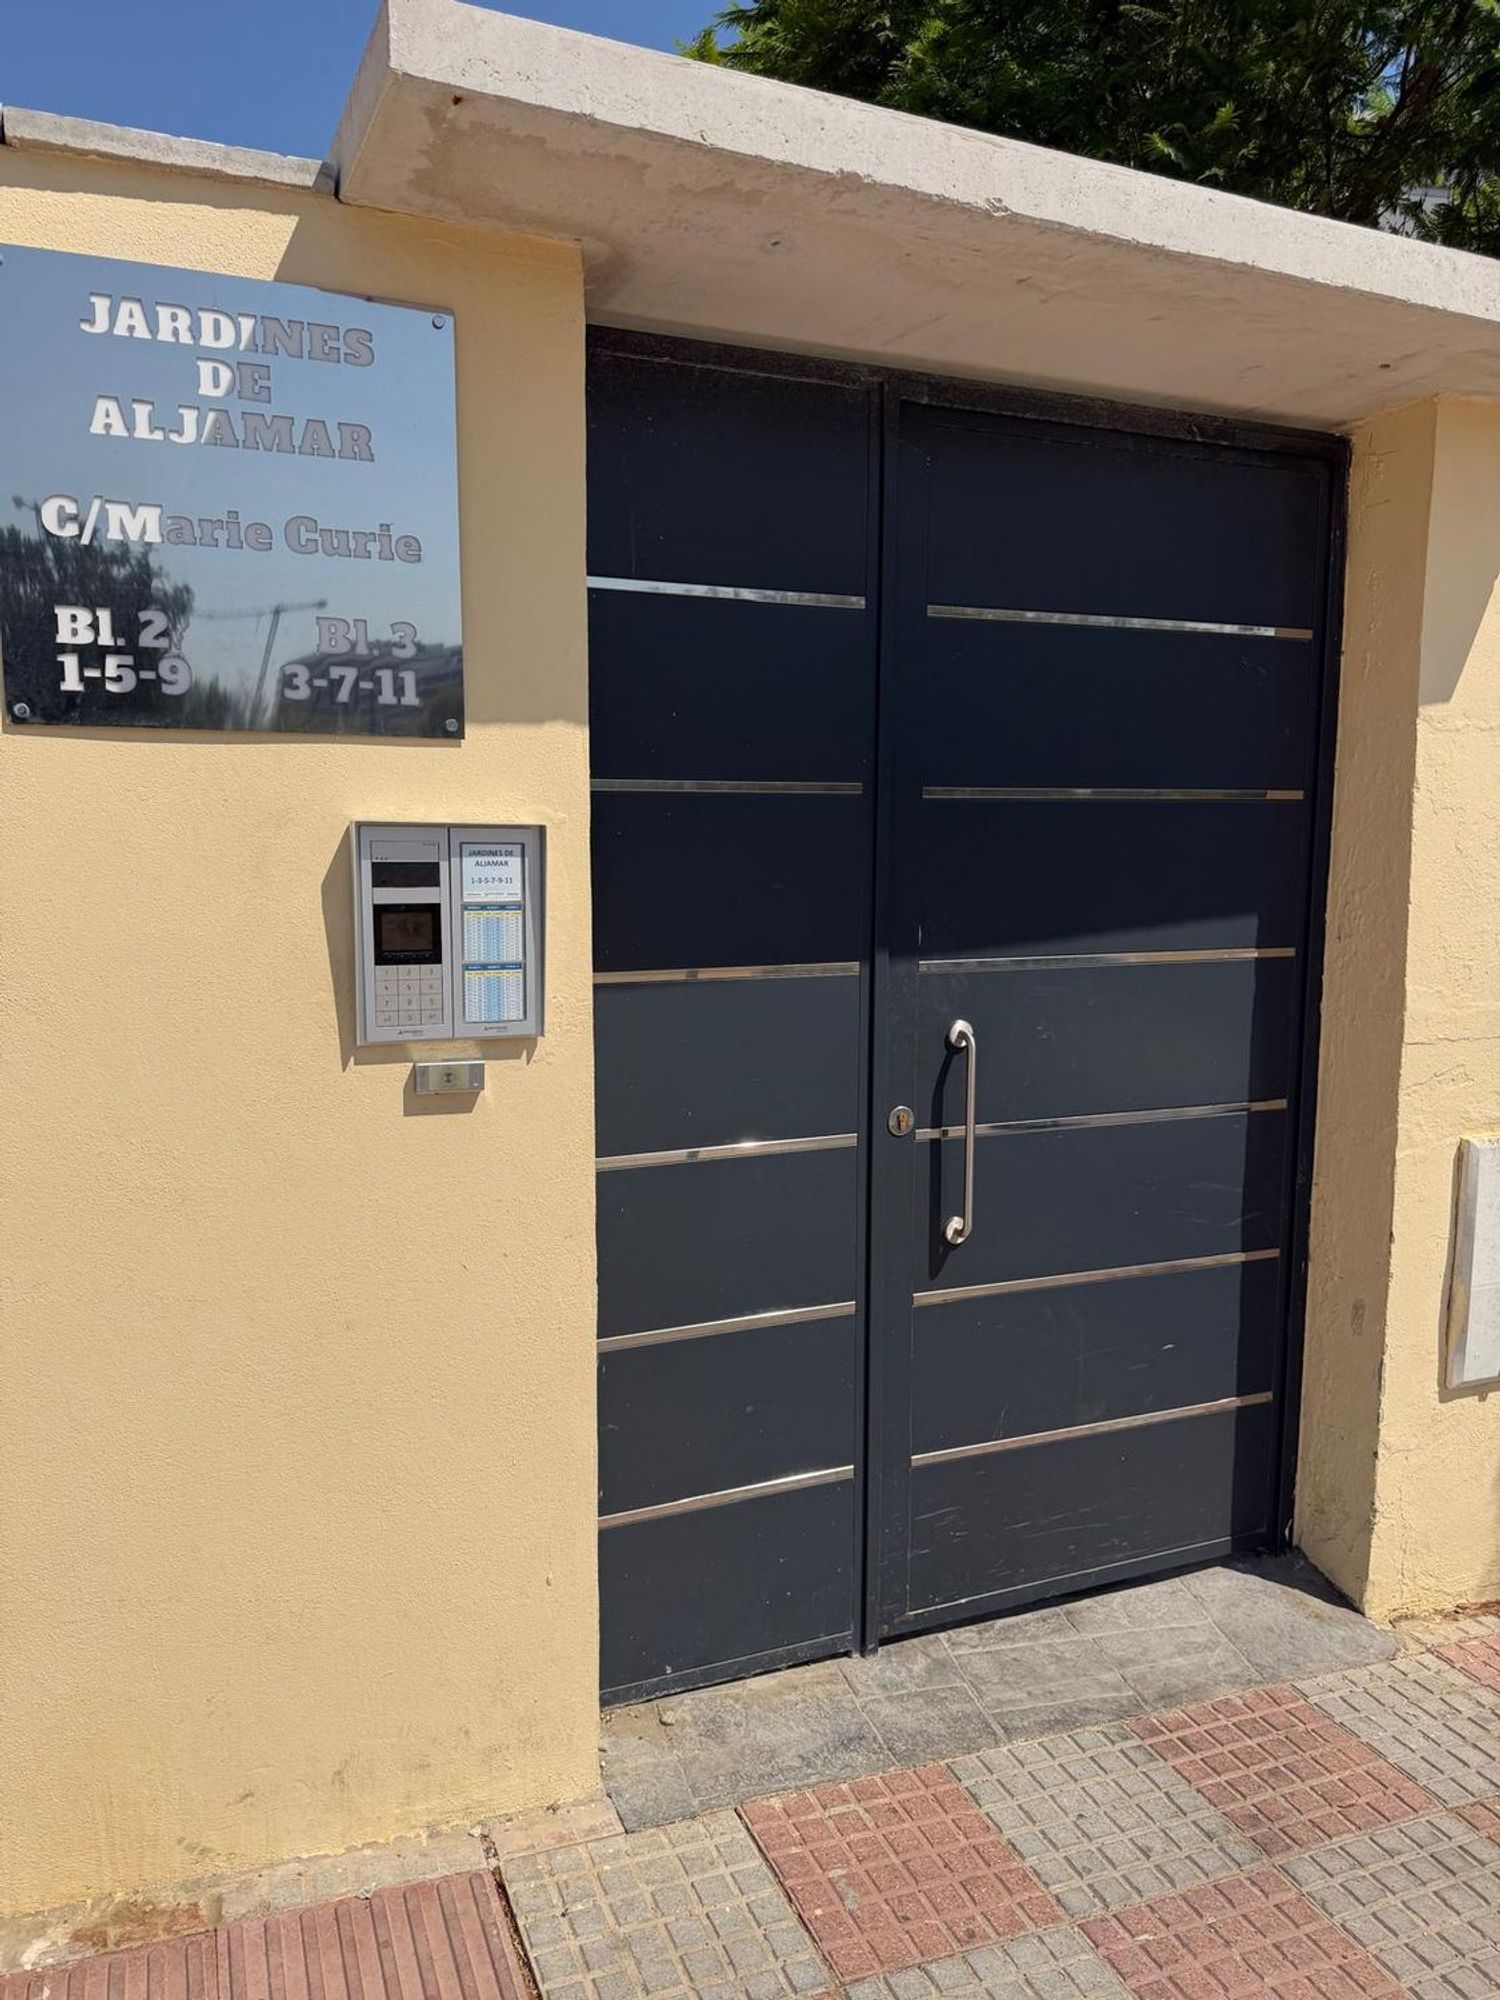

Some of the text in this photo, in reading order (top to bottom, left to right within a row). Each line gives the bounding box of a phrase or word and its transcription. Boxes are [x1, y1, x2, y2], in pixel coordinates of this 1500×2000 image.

[80, 292, 375, 367] JARDINES
[196, 357, 272, 404] DE
[89, 395, 375, 463] ALJAMAR
[40, 494, 423, 564] C/Marie Curie
[137, 609, 170, 649] 2
[390, 621, 419, 660] 3
[57, 653, 193, 695] 1-5-9
[280, 663, 422, 707] 3-7-11
[468, 849, 514, 857] JARDINES DE
[474, 859, 510, 868] ALJAMAR
